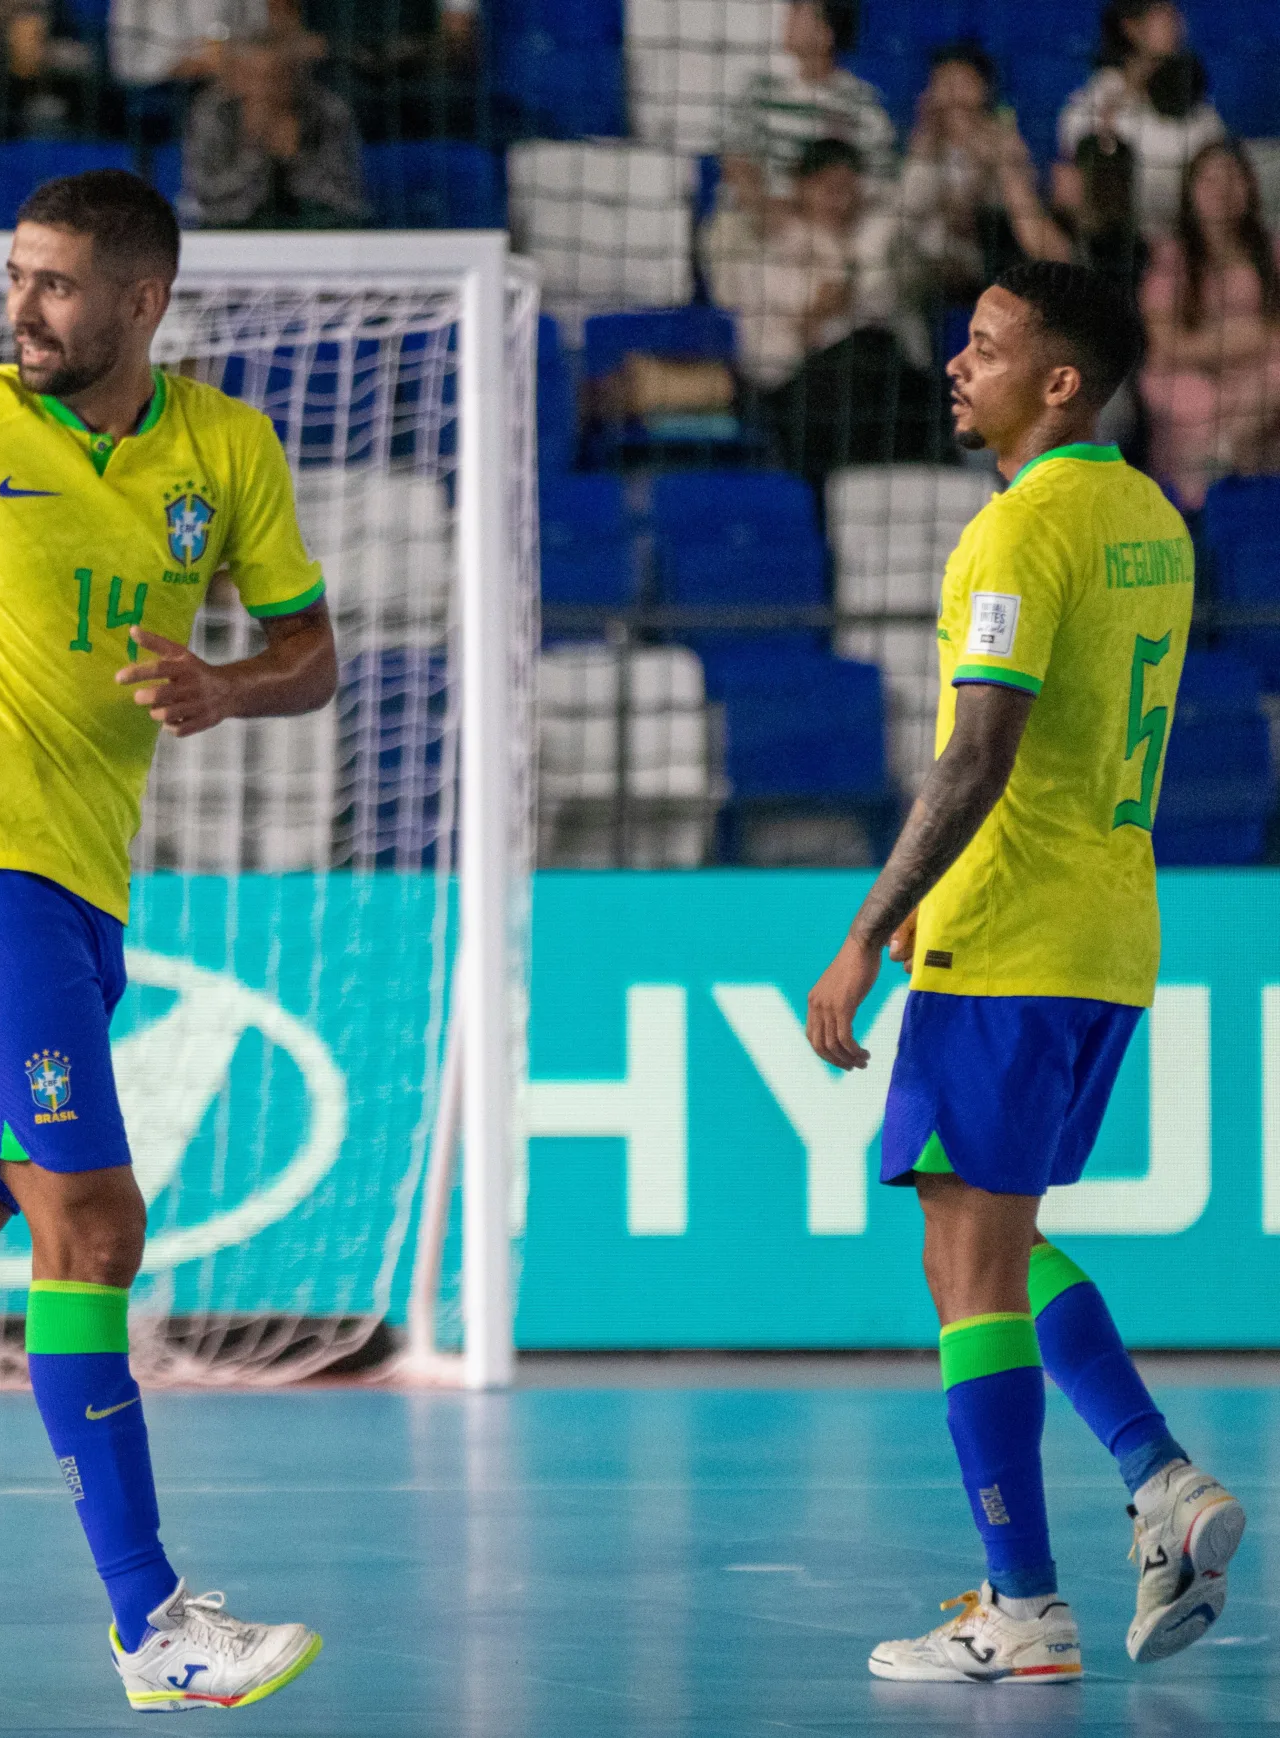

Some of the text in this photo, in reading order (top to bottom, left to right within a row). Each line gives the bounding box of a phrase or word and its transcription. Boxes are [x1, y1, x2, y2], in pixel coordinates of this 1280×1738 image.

[69, 567, 148, 664] 14
[1111, 628, 1172, 833] 5
[34, 1110, 79, 1125] BRASIL
[42, 1080, 58, 1088] CBF
[508, 983, 1280, 1236] HYU
[60, 1455, 85, 1501] BRASIL
